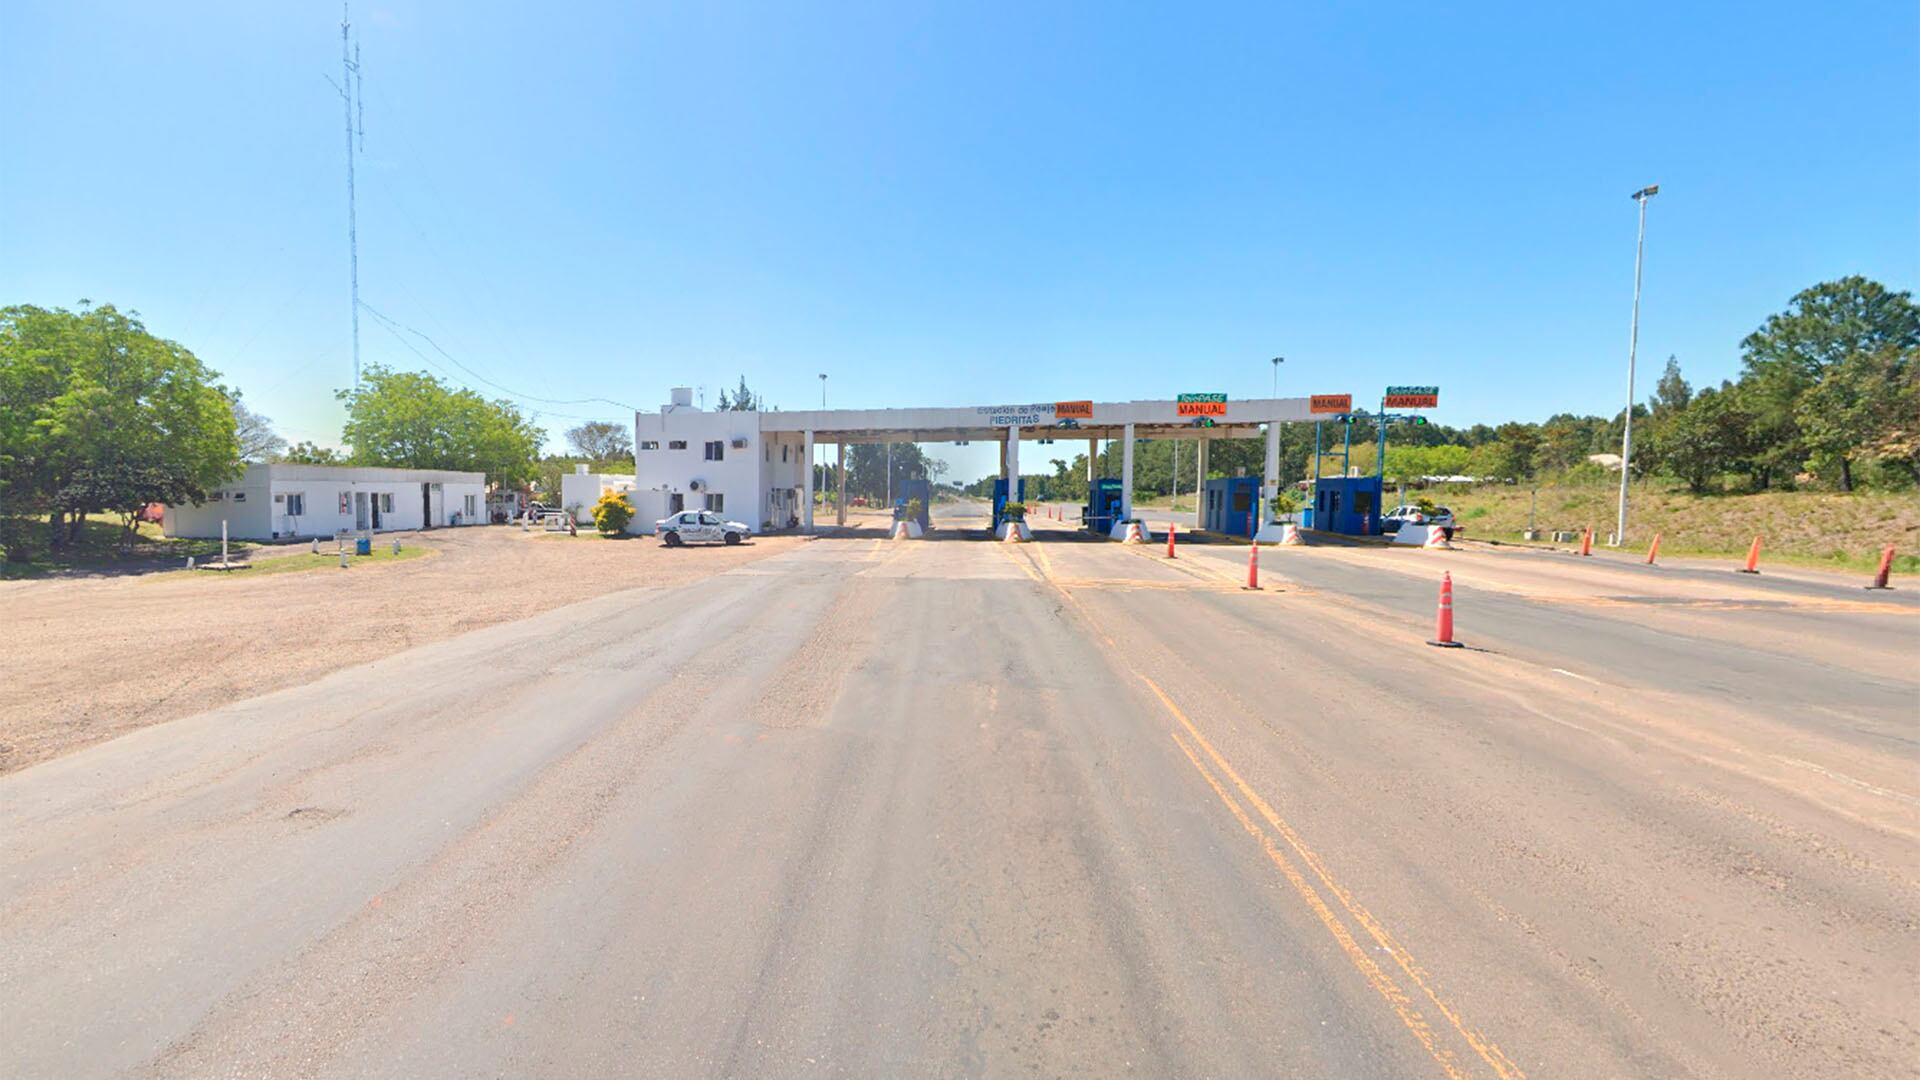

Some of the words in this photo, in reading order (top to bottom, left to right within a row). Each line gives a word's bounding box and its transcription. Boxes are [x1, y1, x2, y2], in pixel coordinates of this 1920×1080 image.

[1312, 398, 1348, 408] MANUAL
[1385, 397, 1435, 407] MANUAL
[1057, 404, 1090, 414] MANUAL
[1179, 404, 1225, 414] MANUAL
[990, 414, 1040, 425] PIEDRITAS
